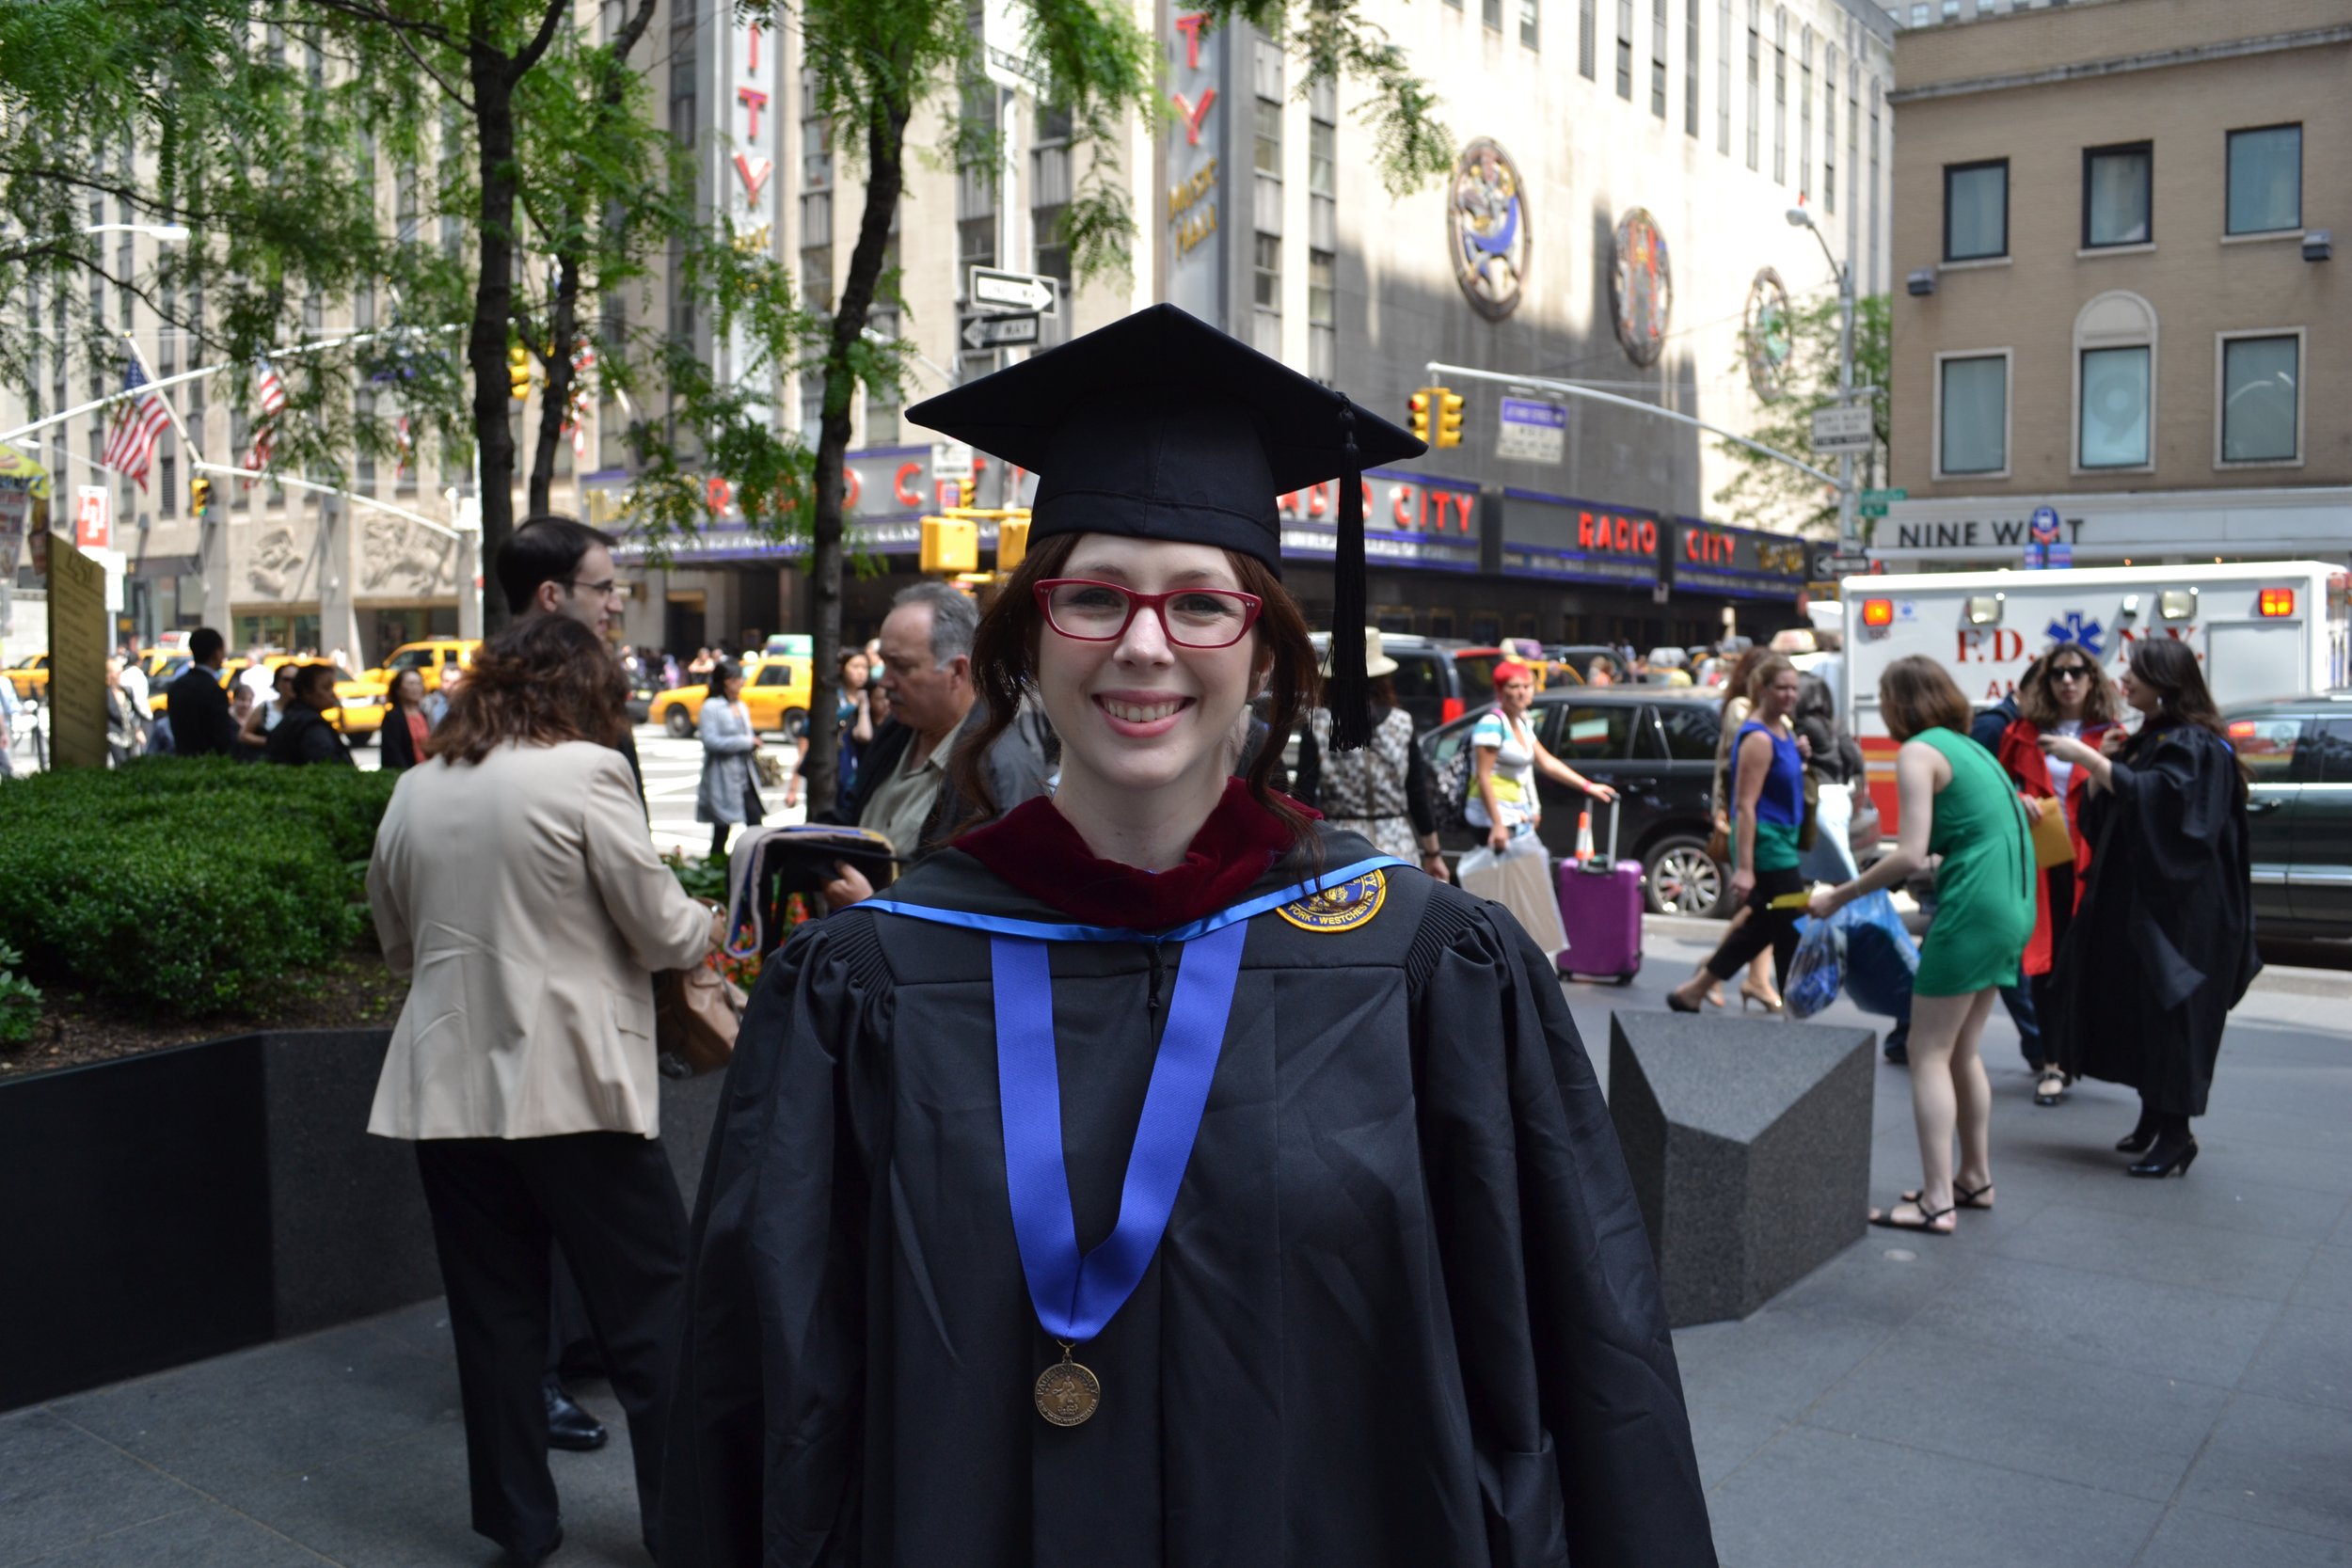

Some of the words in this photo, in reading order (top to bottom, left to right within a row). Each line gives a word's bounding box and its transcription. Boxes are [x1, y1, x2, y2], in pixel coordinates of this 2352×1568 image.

[1394, 486, 1474, 532] CITY
[1578, 511, 1657, 554] RADIO
[1685, 528, 1736, 564] CITY
[1899, 521, 1979, 547] NINE
[1992, 519, 2084, 546] WT
[1288, 904, 1312, 922] YORK
[1319, 891, 1375, 925] WESTCHESTER
